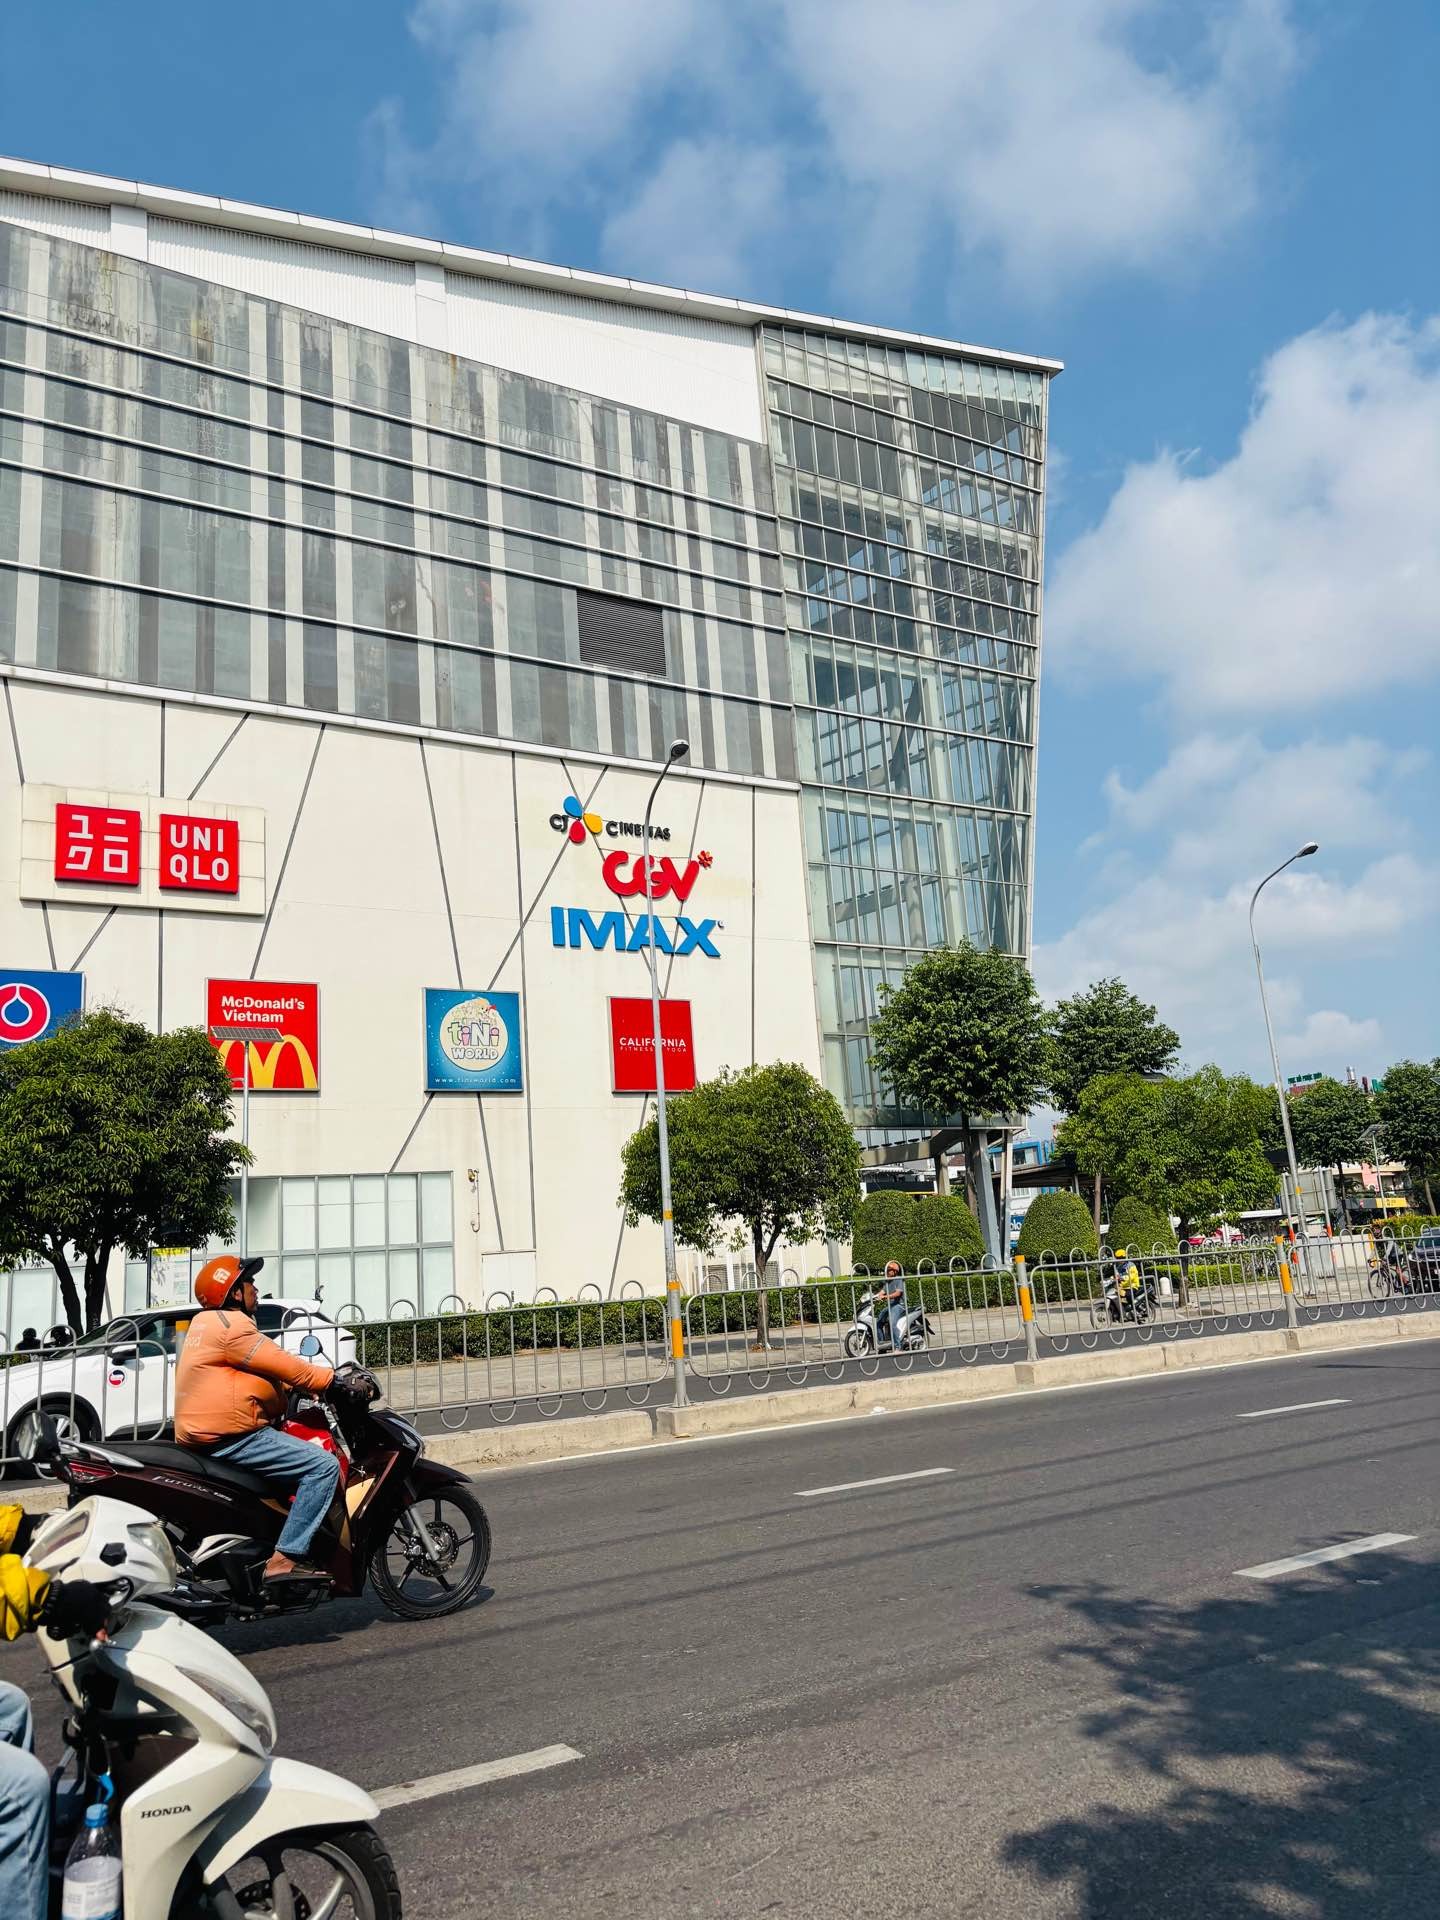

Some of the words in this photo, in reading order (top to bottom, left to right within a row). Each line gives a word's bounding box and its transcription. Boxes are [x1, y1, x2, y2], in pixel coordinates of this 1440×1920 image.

[170, 824, 224, 852] UNI
[169, 854, 230, 883] QLO
[602, 850, 700, 903] CGV
[551, 906, 721, 957] IMAX
[221, 995, 305, 1010] McDonald's
[223, 1009, 284, 1023] Vietnam
[451, 1048, 500, 1060] WORLD
[141, 1804, 192, 1819] HONDA
